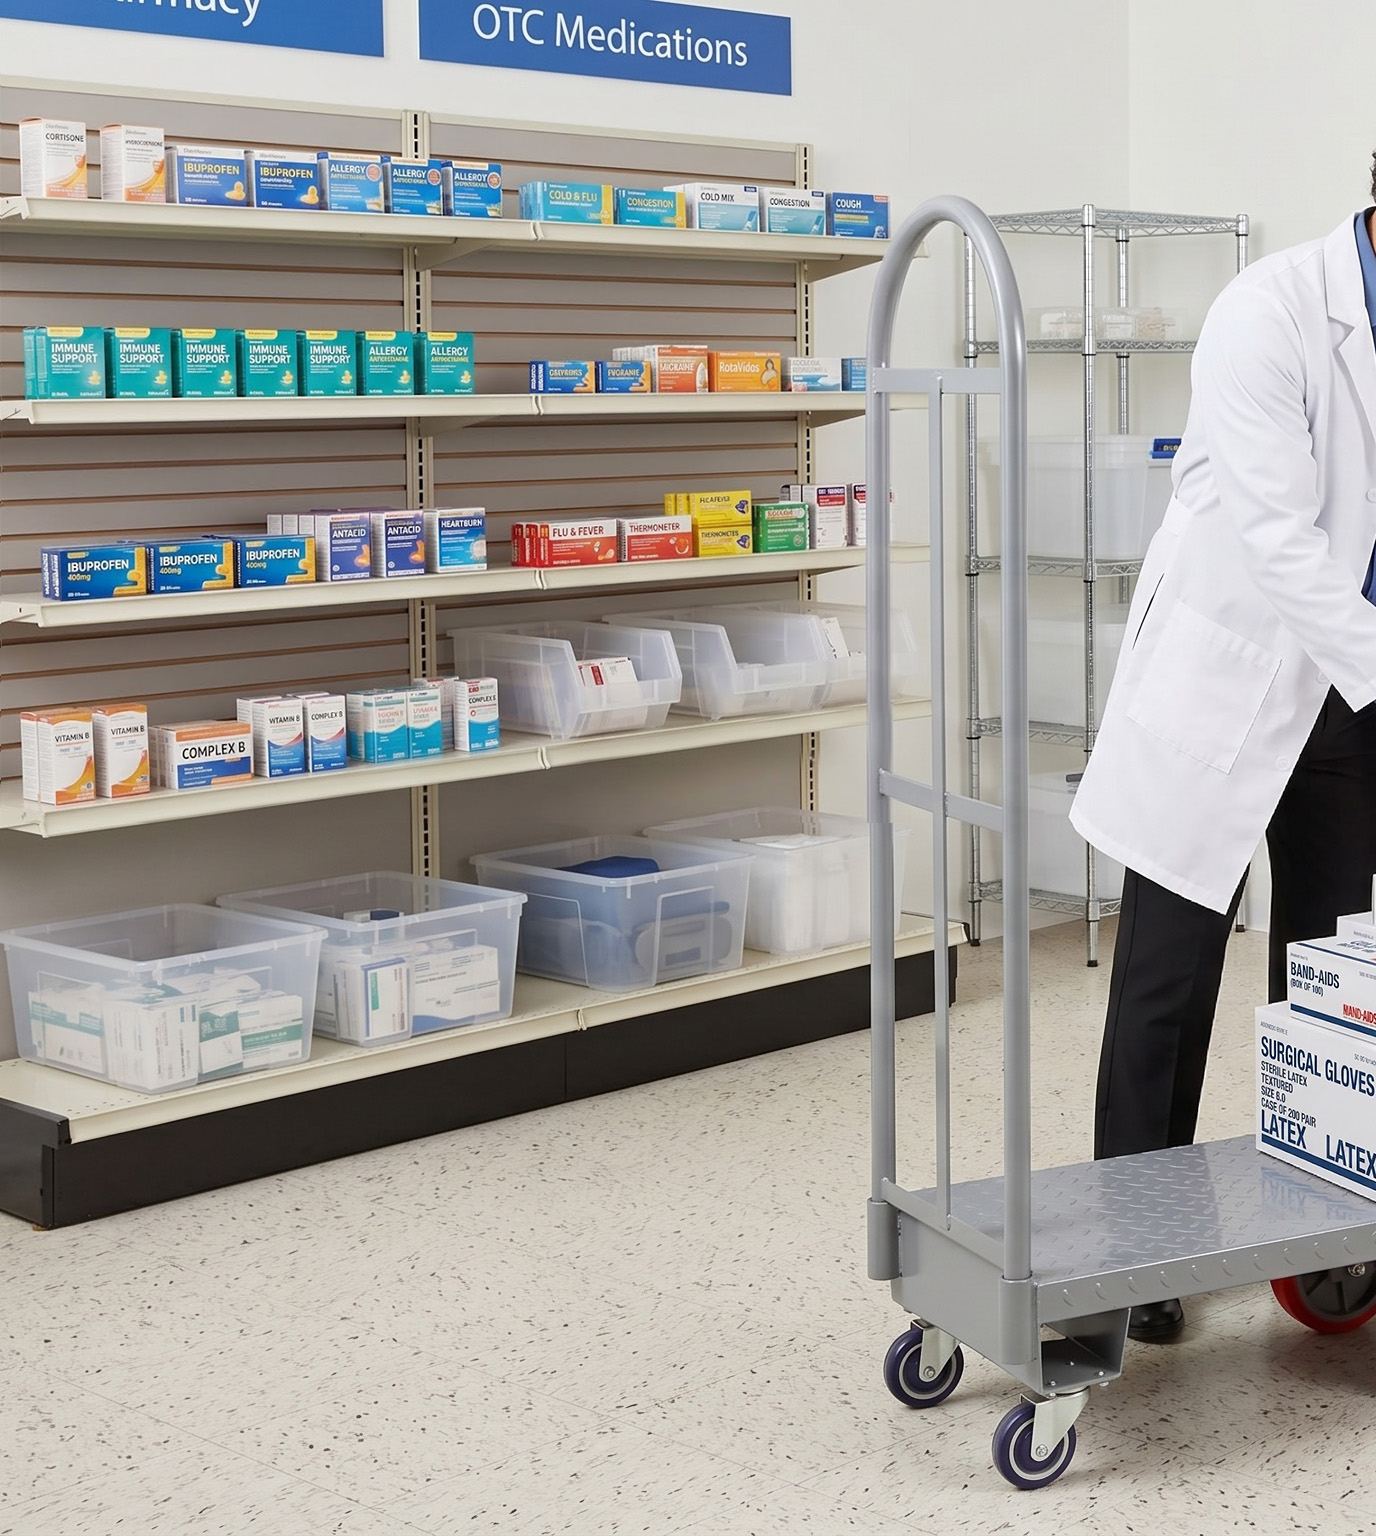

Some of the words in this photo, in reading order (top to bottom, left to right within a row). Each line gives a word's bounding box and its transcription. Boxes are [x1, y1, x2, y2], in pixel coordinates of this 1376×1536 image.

[473, 4, 544, 45] OTC
[555, 12, 748, 66] Medications
[45, 133, 84, 143] CORTISONE
[184, 163, 240, 175] IBUPROFEN
[260, 167, 313, 179] IBUPROFEN
[330, 163, 366, 175] ALLERGY
[393, 168, 427, 179] ALLERGY
[549, 190, 571, 201] COLD
[582, 193, 598, 202] FLU
[700, 192, 720, 201] COLD
[721, 193, 735, 202] MIX
[627, 199, 674, 208] CONGESTION
[836, 199, 861, 209] COUGH
[51, 344, 94, 353] IMMUNE
[119, 344, 161, 353] IMMUNE
[369, 346, 408, 356] ALLERGY
[430, 346, 468, 356] ALLERGY
[51, 353, 98, 363] SUPPORT
[119, 354, 164, 364] SUPPORT
[719, 361, 760, 373] RotaVidos
[441, 518, 483, 528] HEARTBURN
[332, 529, 366, 538] ANTACID
[387, 525, 421, 535] ANTACID
[552, 527, 568, 537] FLU
[570, 527, 576, 536] &
[578, 525, 604, 535] FEVER
[159, 553, 217, 567] IBUPROFEN
[246, 548, 300, 562] IBUPROFEN
[67, 559, 129, 573] IBUPROFEN
[159, 566, 182, 576] 400mg
[67, 573, 91, 582] 400mg
[111, 726, 138, 735] VITAMIN
[54, 734, 84, 743] VITAMIN
[182, 742, 236, 760] COMPLEX
[238, 741, 246, 753] B
[1290, 961, 1340, 989] BAND-AIDS
[1303, 982, 1310, 991] OF
[1311, 983, 1324, 997] 100)
[1261, 1035, 1321, 1077] SURGICAL
[1325, 1059, 1375, 1097] GLOVES
[1261, 1061, 1287, 1078] STERILE
[1287, 1072, 1308, 1087] LATEX
[1261, 1073, 1293, 1094] TEXTURED
[1261, 1085, 1275, 1099] SIZE
[1261, 1097, 1277, 1113] CASE
[1278, 1104, 1287, 1116] OF
[1288, 1108, 1301, 1121] 200
[1301, 1112, 1316, 1128] PAIR
[1261, 1109, 1307, 1150] LATEX
